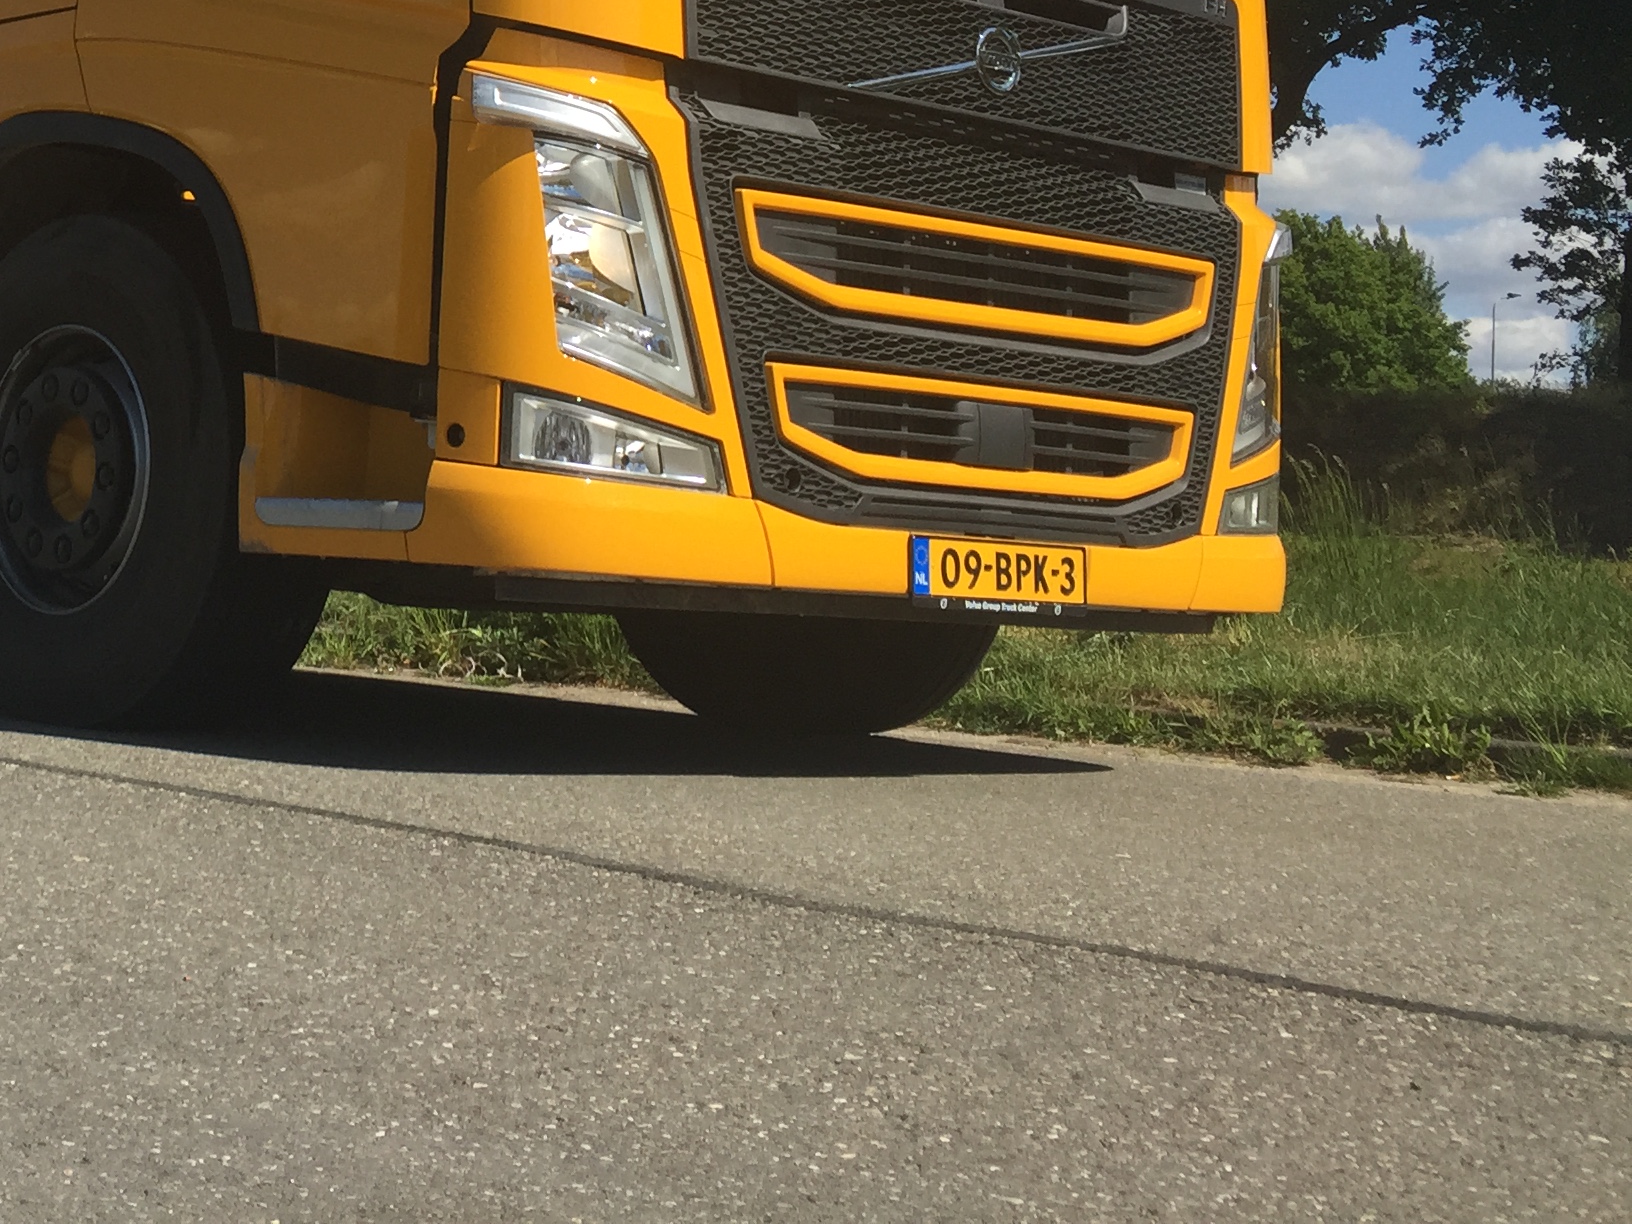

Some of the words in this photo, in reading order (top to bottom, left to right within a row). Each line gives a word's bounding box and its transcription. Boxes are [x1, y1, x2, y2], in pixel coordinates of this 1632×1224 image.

[940, 547, 1076, 596] 09-BPK-3
[915, 572, 928, 586] NL
[982, 601, 1001, 613] Group
[1001, 602, 1017, 612] Truck
